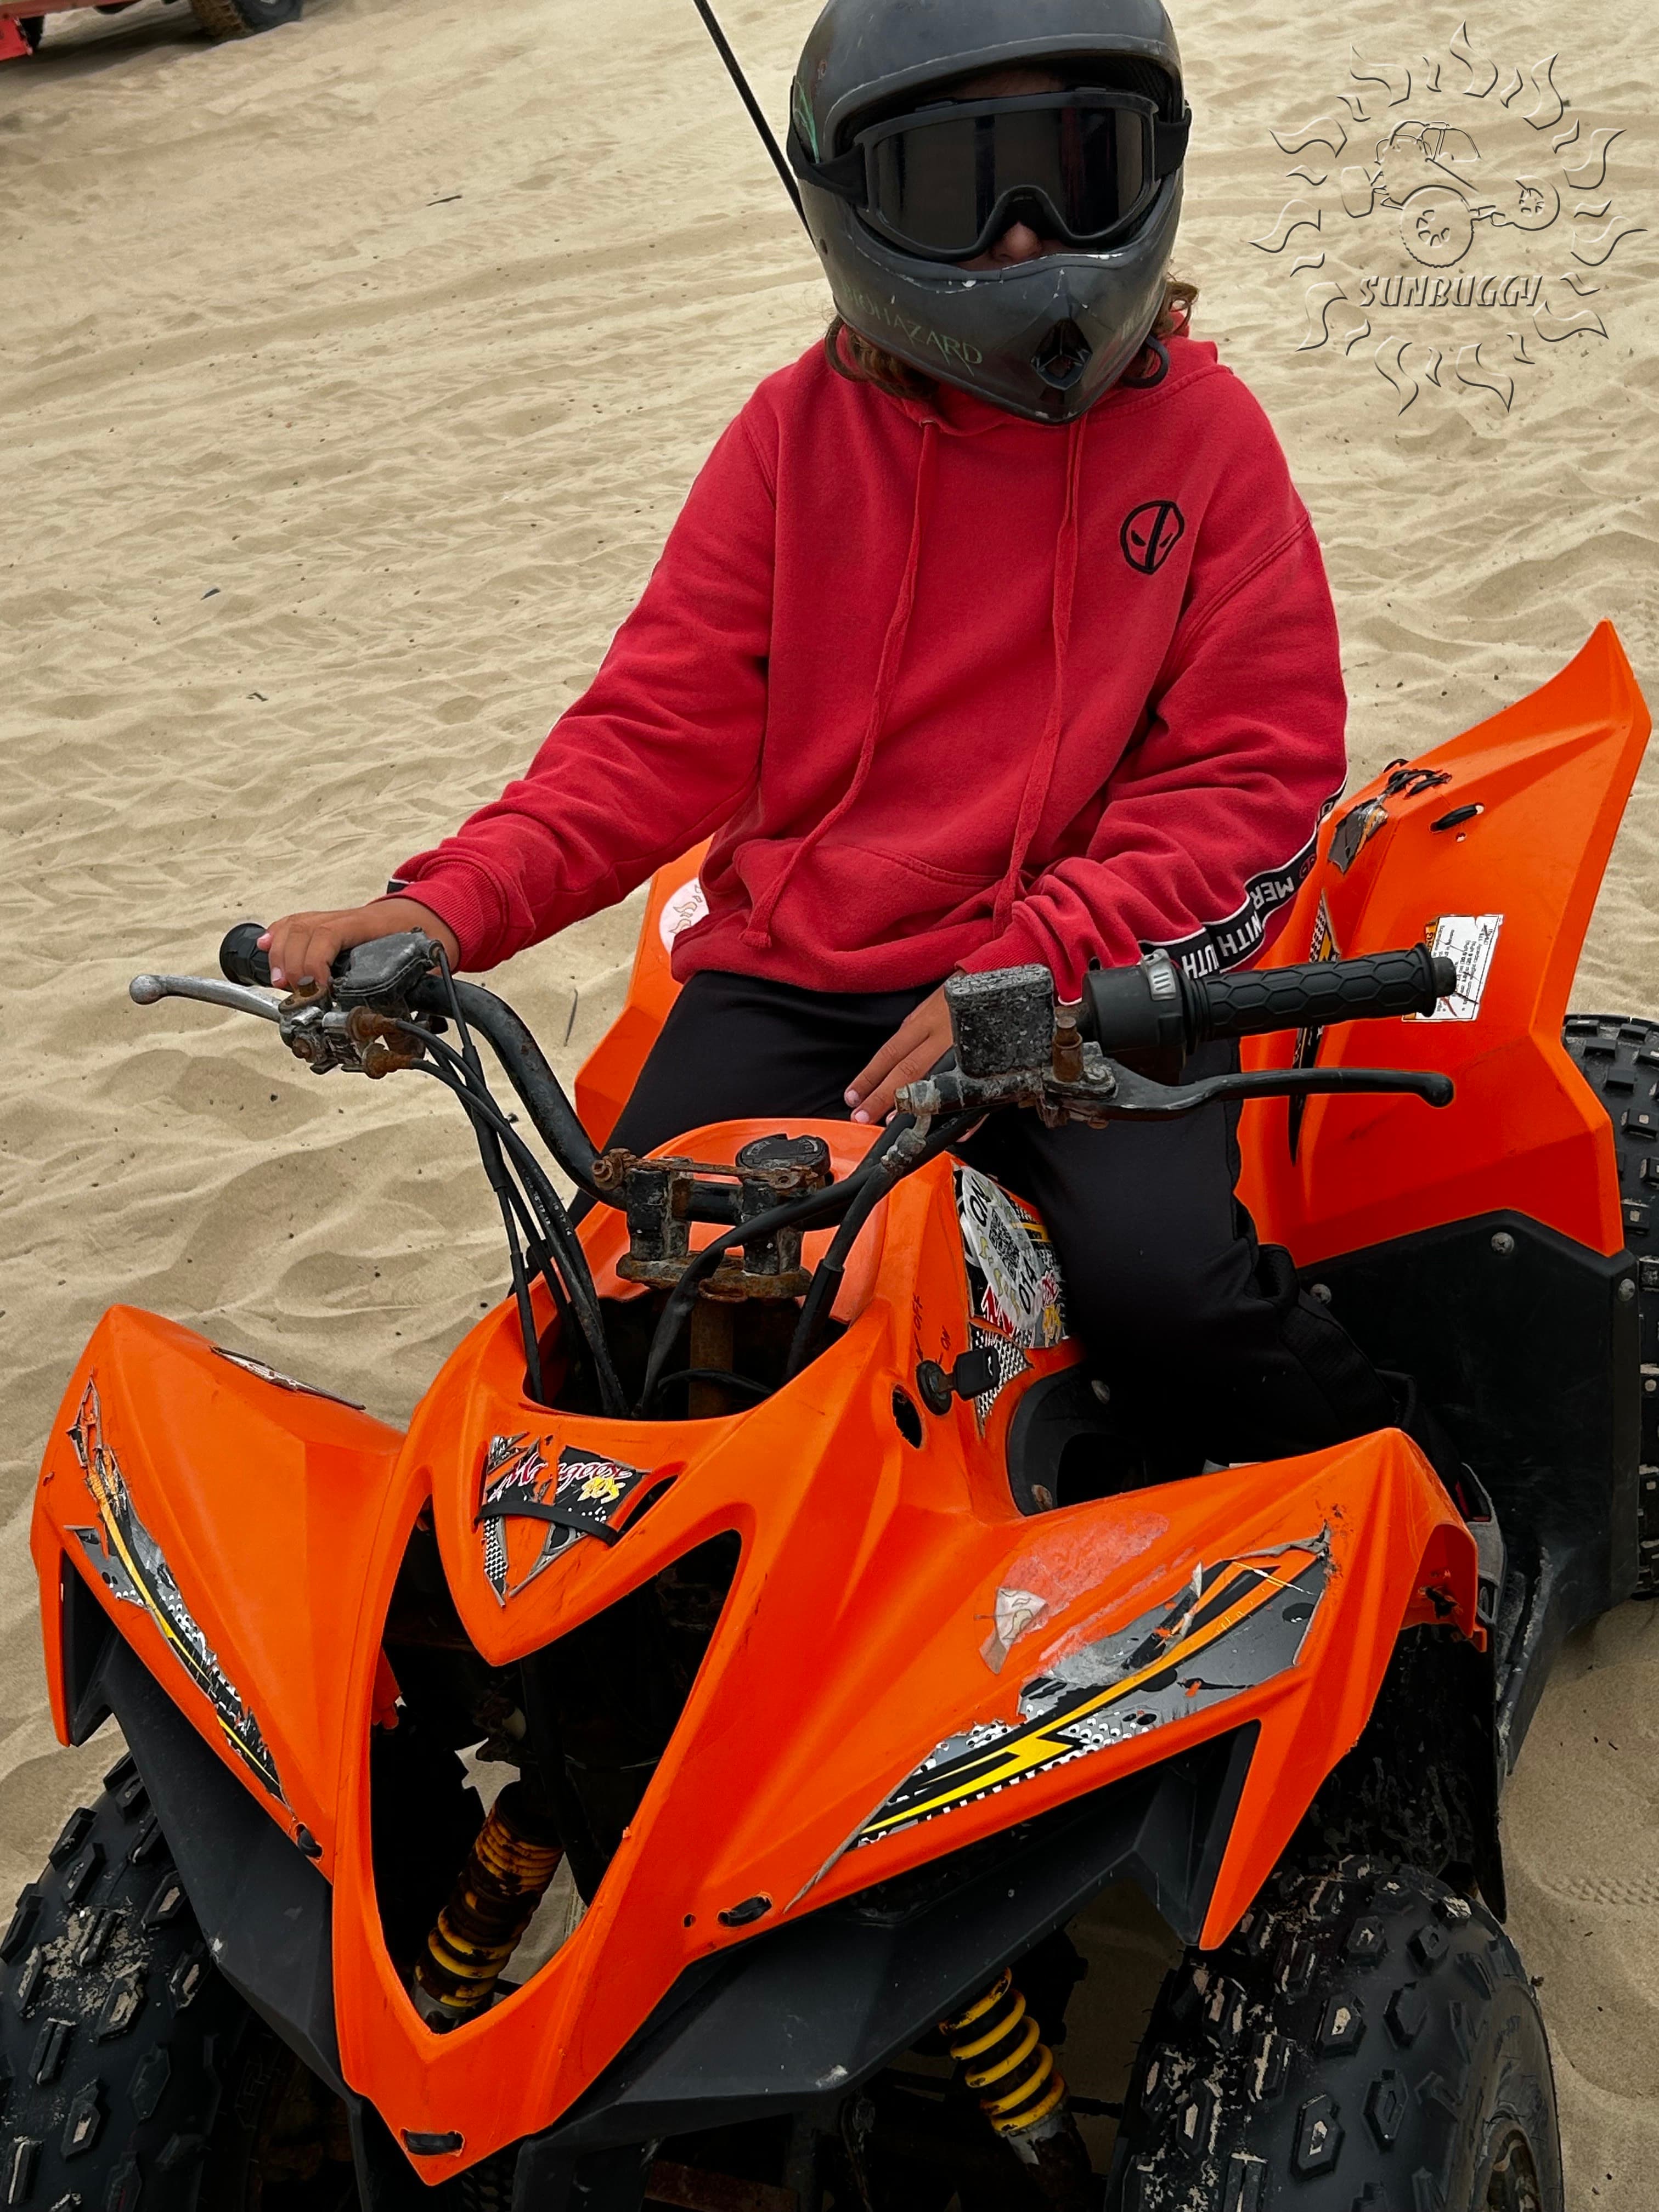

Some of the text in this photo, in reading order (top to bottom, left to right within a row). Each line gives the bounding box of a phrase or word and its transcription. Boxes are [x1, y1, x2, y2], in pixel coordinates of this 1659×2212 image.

[1249, 876, 1295, 910] MER
[1181, 943, 1220, 979] UTH
[912, 1291, 923, 1331] OFF
[940, 1325, 951, 1351] ON
